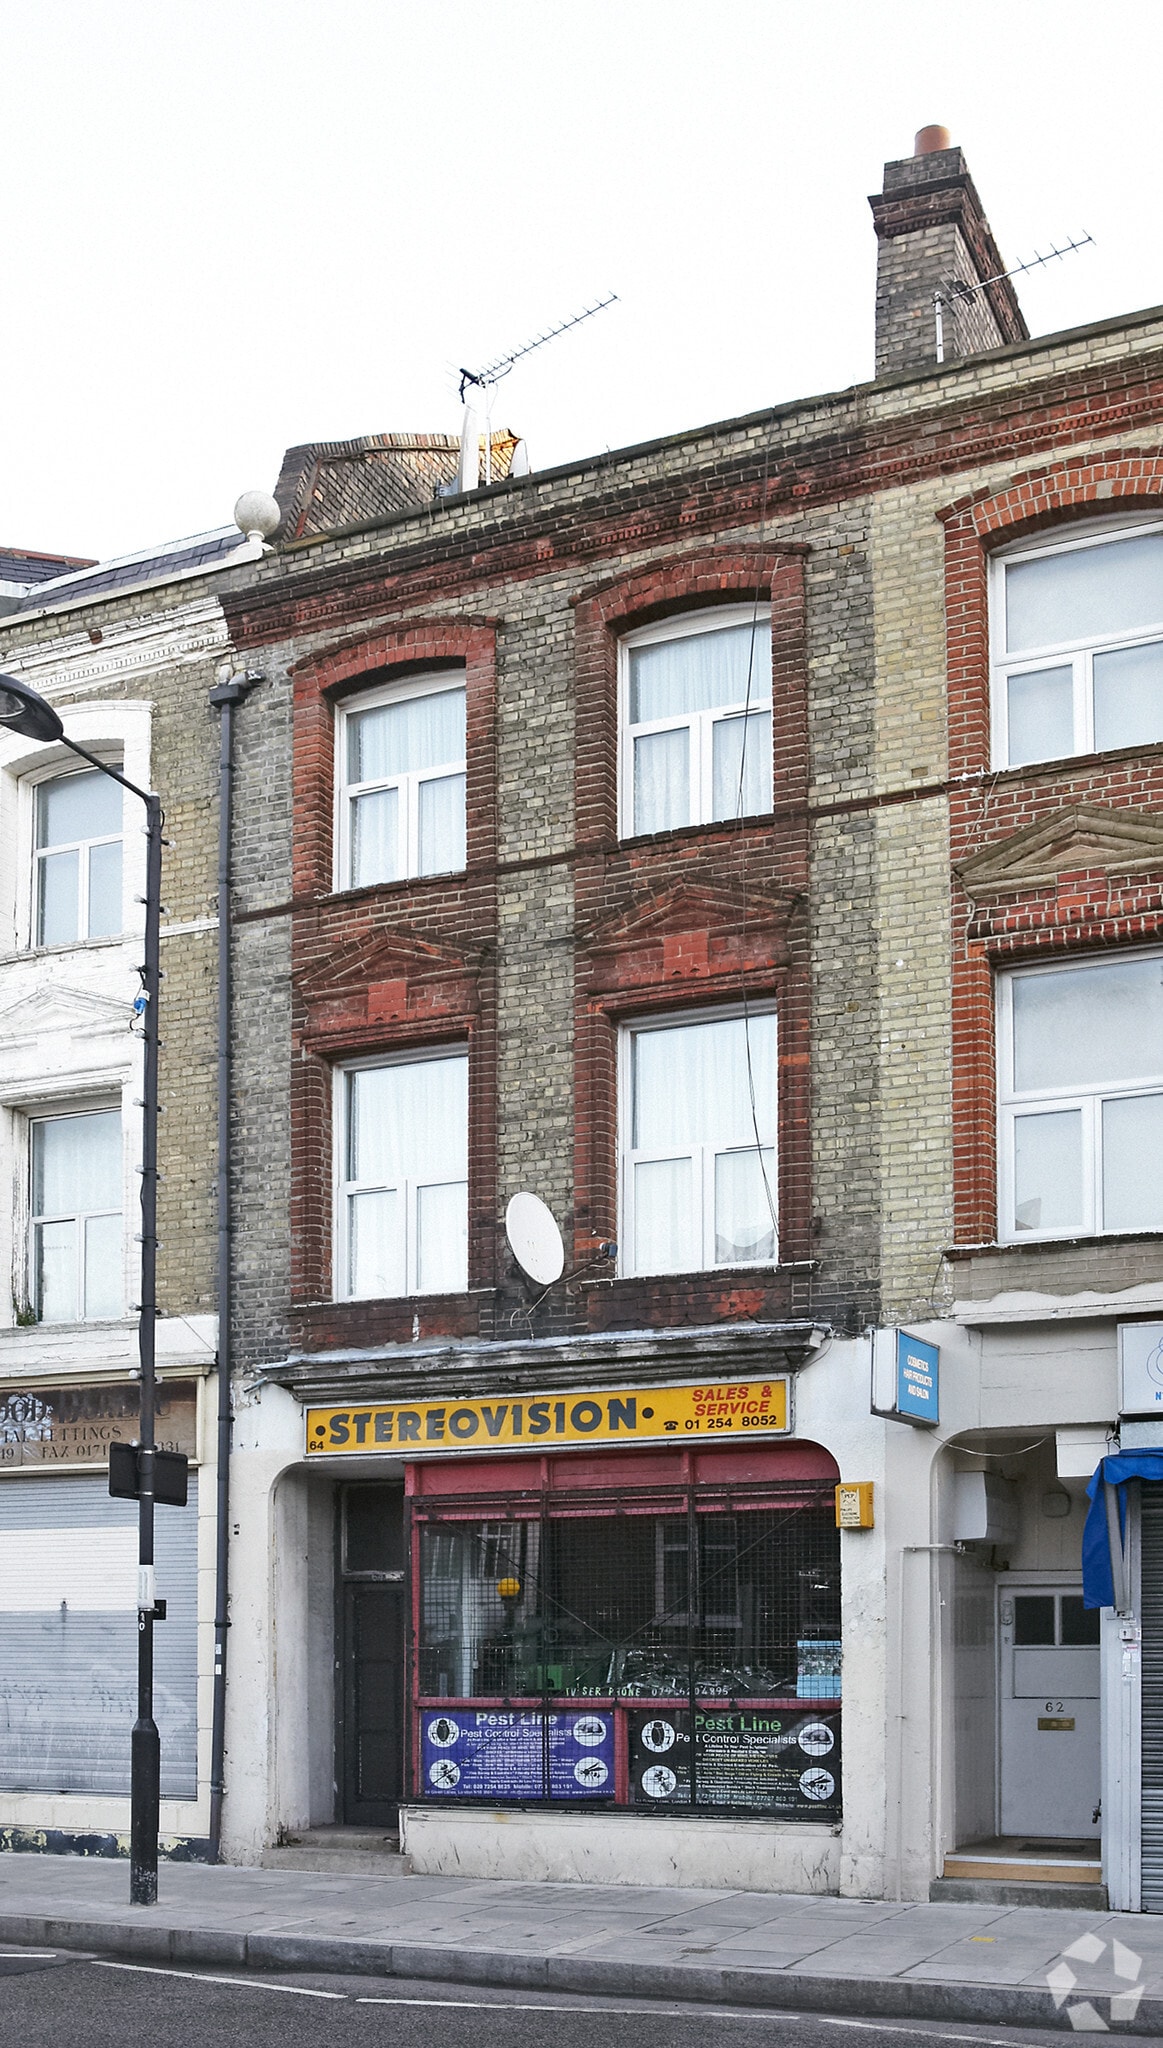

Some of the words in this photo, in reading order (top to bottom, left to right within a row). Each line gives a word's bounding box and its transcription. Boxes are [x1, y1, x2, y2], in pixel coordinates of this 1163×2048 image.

[692, 1386, 749, 1402] SALES
[761, 1385, 773, 1398] &
[695, 1401, 770, 1417] SERVICE
[329, 1398, 637, 1445] STEREOVISION
[685, 1420, 699, 1430] 01
[707, 1417, 733, 1429] 254
[741, 1415, 777, 1427] 8052
[41, 1425, 122, 1442] LETTINGS
[42, 1446, 69, 1459] FAX
[76, 1444, 106, 1457] 0171
[310, 1441, 324, 1450] 64
[582, 1687, 601, 1697] SER
[1045, 1701, 1065, 1713] 62
[476, 1711, 514, 1726] Pest
[520, 1711, 558, 1726] Line
[695, 1716, 734, 1732] Pest
[740, 1717, 782, 1732] Line
[461, 1729, 482, 1739] Pest
[484, 1728, 520, 1739] Control
[676, 1733, 700, 1744] Pet
[703, 1733, 740, 1745] Control
[742, 1734, 797, 1746] Specialists
